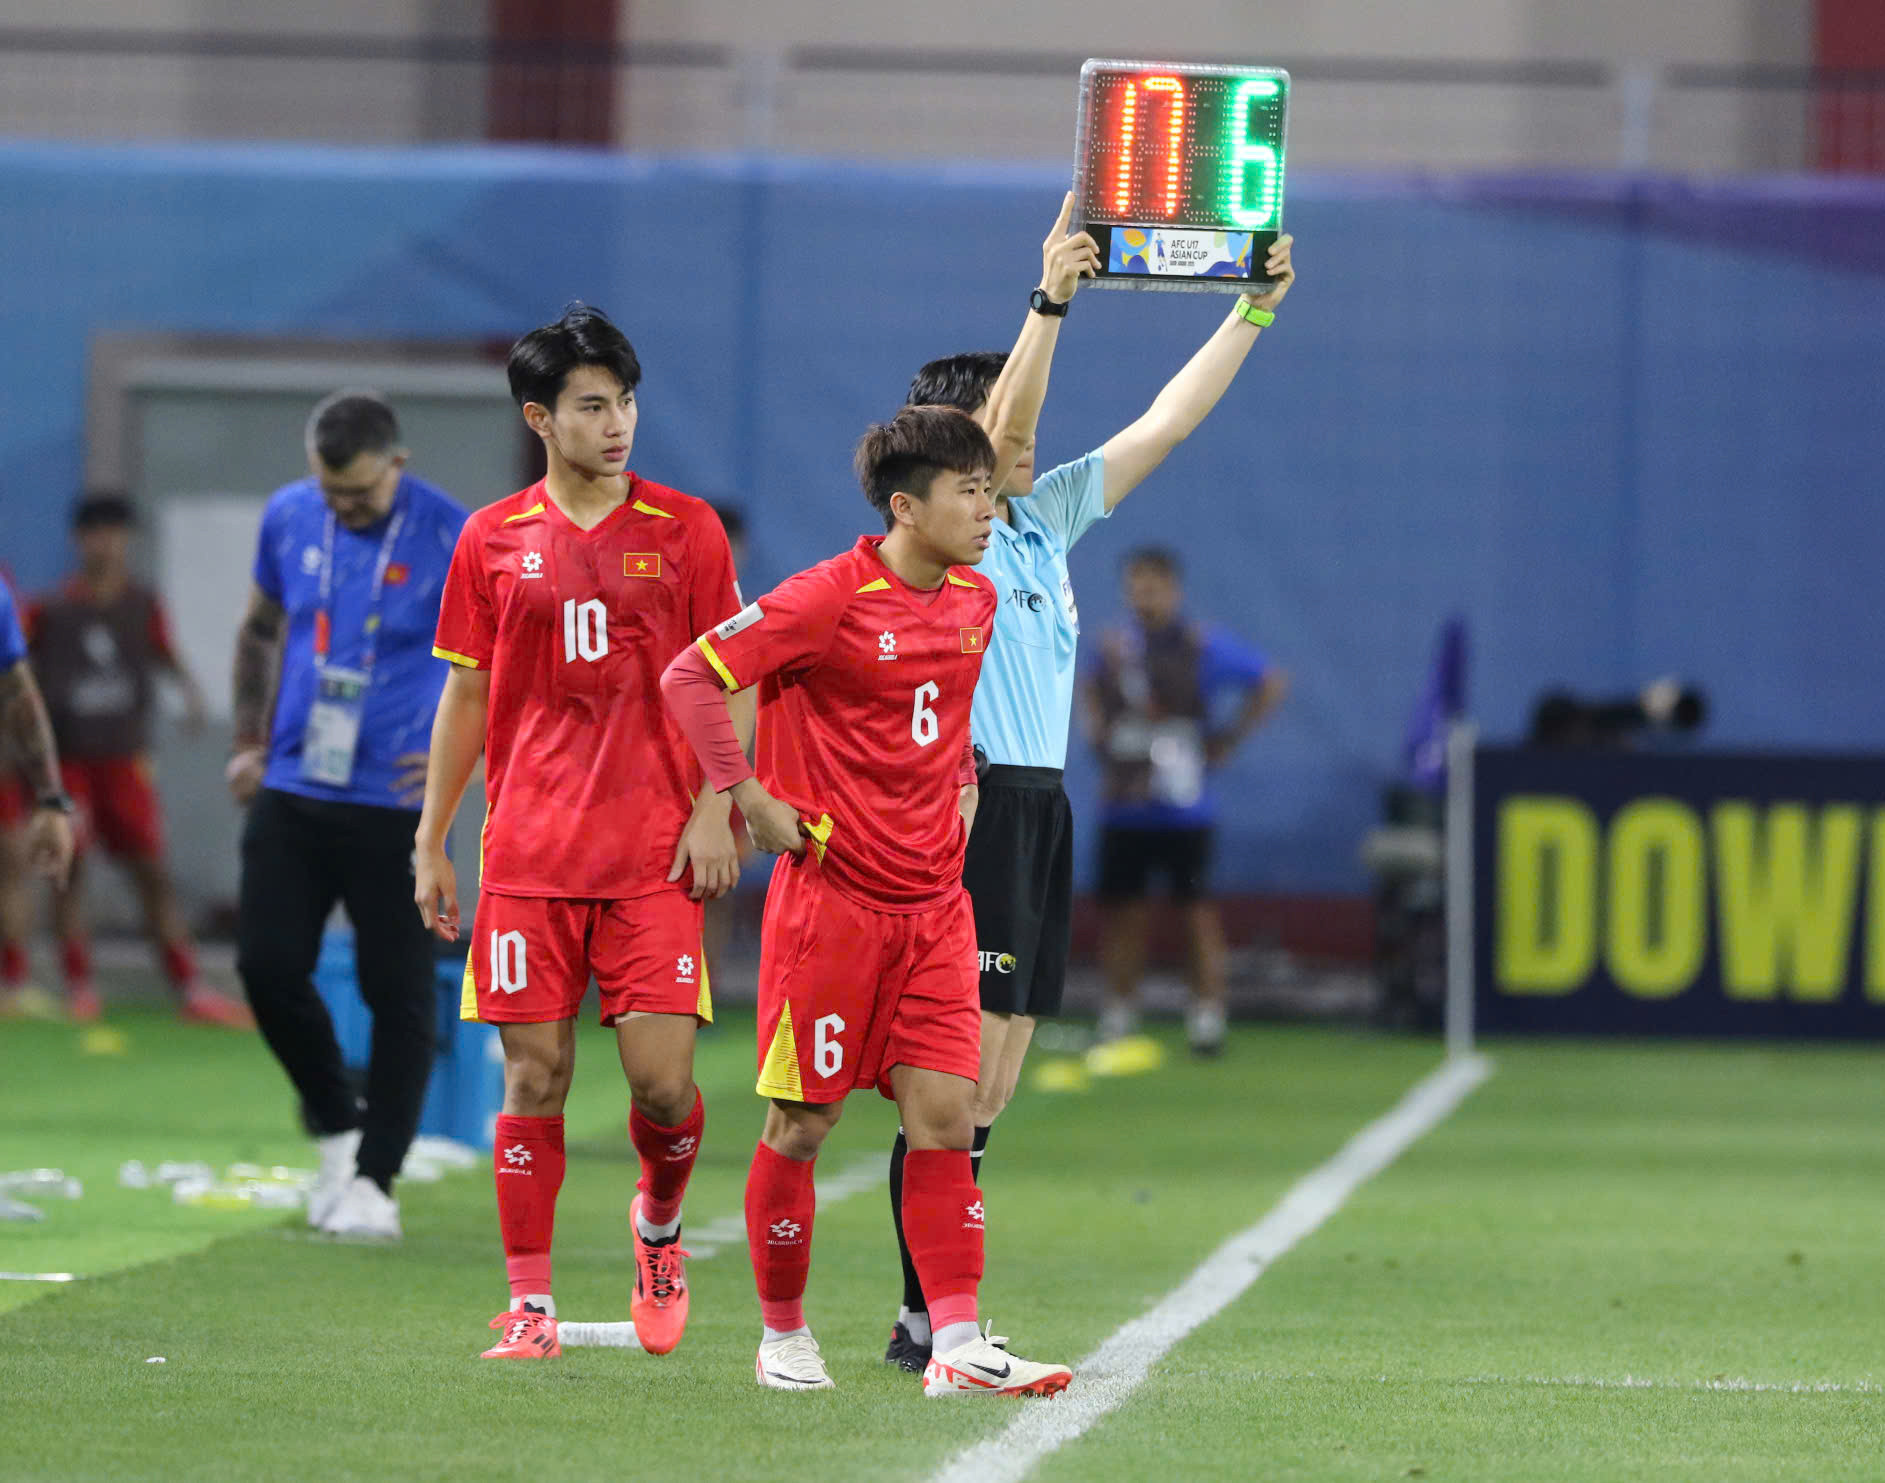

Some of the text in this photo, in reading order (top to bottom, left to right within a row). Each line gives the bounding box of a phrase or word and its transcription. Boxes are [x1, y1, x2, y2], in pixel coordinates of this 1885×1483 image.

[1116, 76, 1279, 226] 17 6
[1170, 250, 1208, 261] ASIAN CUP
[1171, 240, 1199, 249] AFC U17
[563, 598, 609, 664] 10
[911, 680, 940, 747] 6
[1494, 794, 1885, 1002] DOW
[490, 929, 528, 995] 10
[814, 1012, 846, 1079] 6
